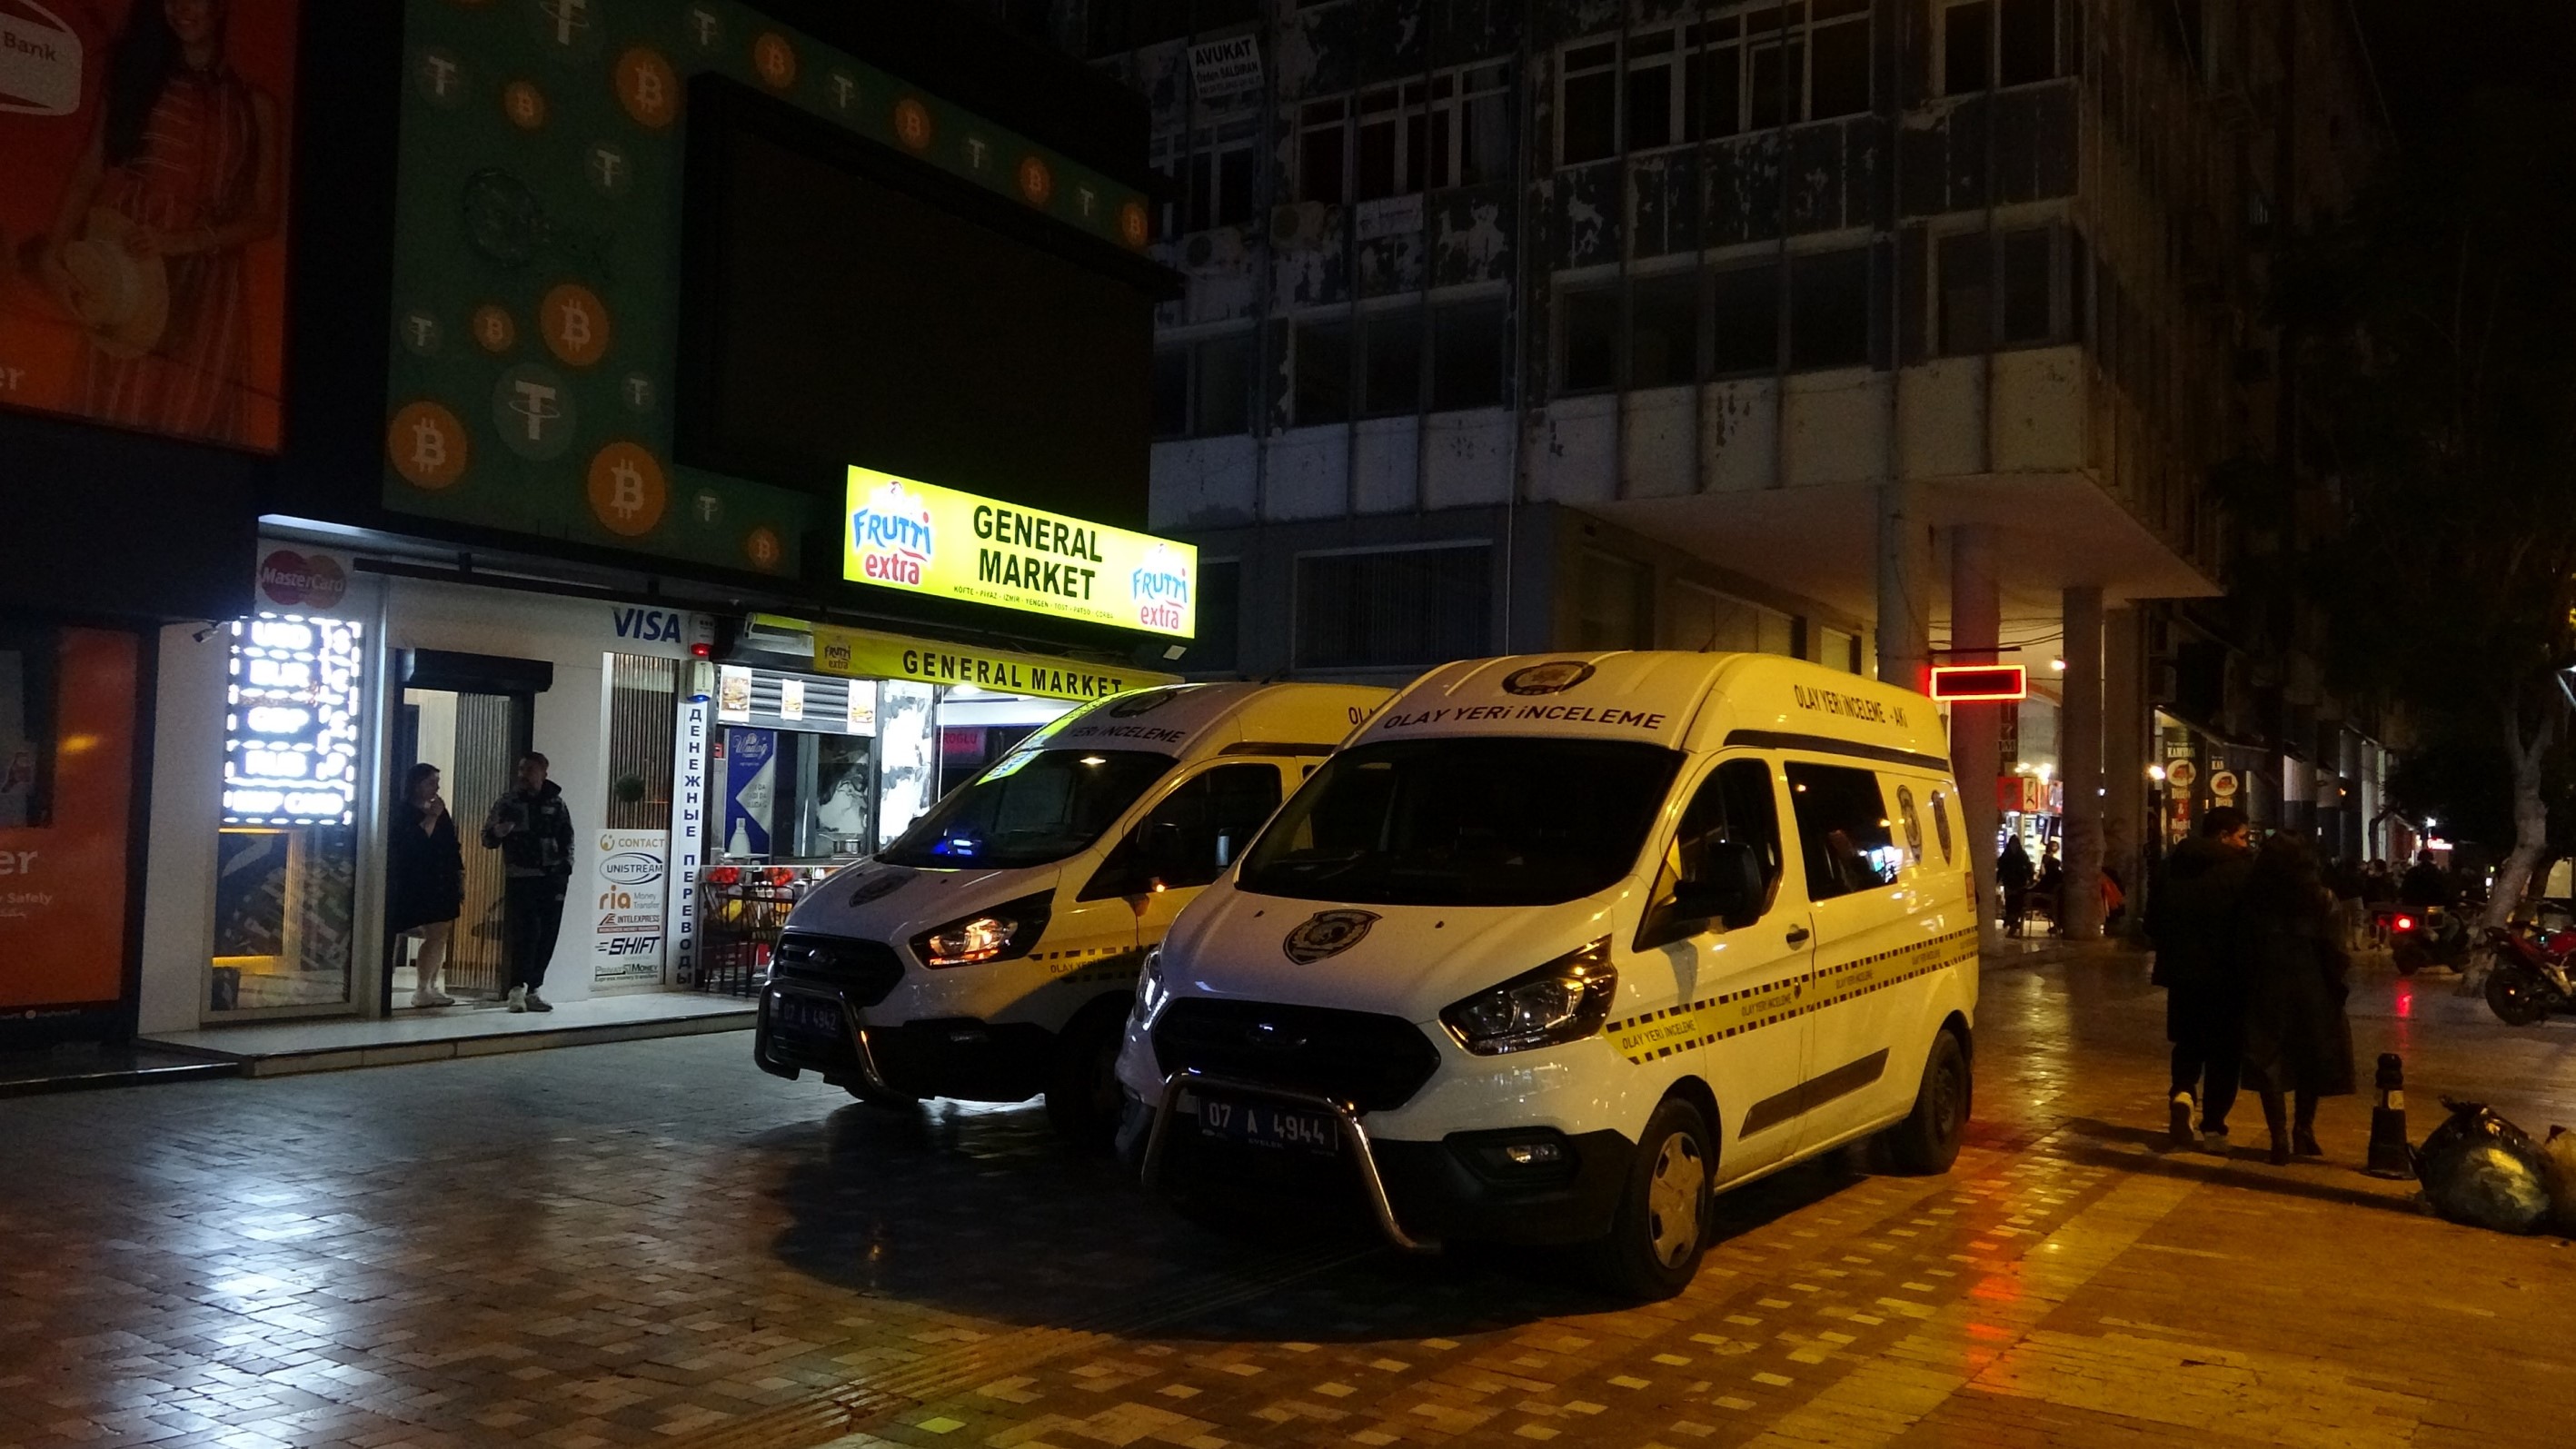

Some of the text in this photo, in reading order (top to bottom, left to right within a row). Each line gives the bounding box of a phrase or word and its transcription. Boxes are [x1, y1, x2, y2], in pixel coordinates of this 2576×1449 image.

[4, 31, 56, 61] Bank
[1196, 39, 1251, 65] AVUKAT
[973, 504, 1103, 563] GENERAL
[261, 567, 344, 592] MasterCard
[865, 553, 920, 585] extra
[979, 548, 1096, 600] MARKET
[1025, 598, 1049, 608] YENGEN
[609, 606, 681, 644] VISA
[1140, 605, 1179, 630] extra
[902, 649, 1123, 699] GENERAL MARKET
[1794, 684, 1822, 711] OLAY
[1383, 708, 1451, 729] OLAY
[683, 709, 702, 838] ДЕНЕЖНЫЕ
[618, 839, 665, 848] CONTACT
[606, 864, 663, 873] UNISTREAM
[6, 892, 53, 905] Safely
[599, 885, 632, 910] ria
[633, 892, 656, 900] Money
[633, 901, 661, 909] Transfer
[617, 914, 661, 924] INTELEXPRESS
[676, 854, 695, 985] ПЕРЕВОДЫ
[609, 936, 661, 956] SHIFT
[1050, 963, 1074, 974] OLAY
[1622, 1034, 1644, 1050] OLAY
[1208, 1102, 1232, 1128] 07
[1246, 1108, 1258, 1135] A
[1273, 1113, 1325, 1146] 4944
